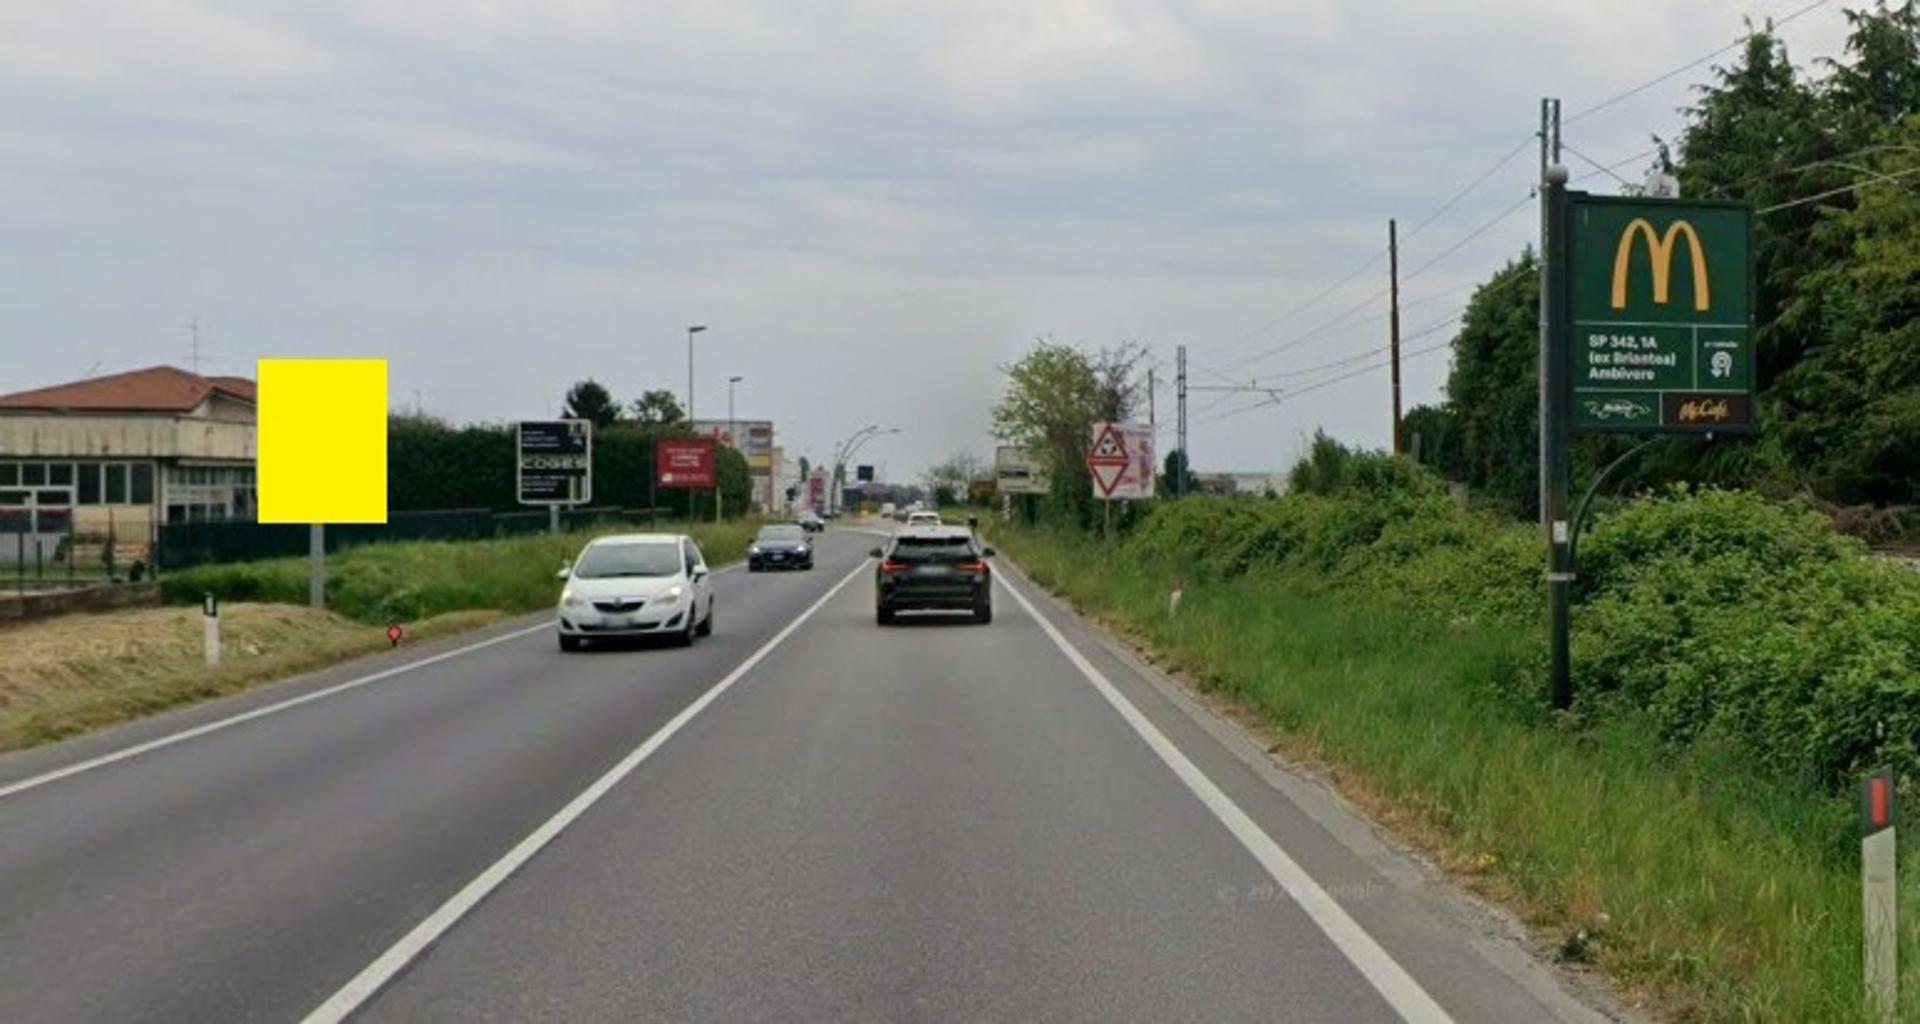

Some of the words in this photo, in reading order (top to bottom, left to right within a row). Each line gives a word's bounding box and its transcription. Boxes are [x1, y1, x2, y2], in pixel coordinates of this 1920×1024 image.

[1589, 334, 1608, 348] SP
[1610, 335, 1639, 349] 342,
[1641, 336, 1658, 349] 1A
[1589, 366, 1655, 380] Ambivere
